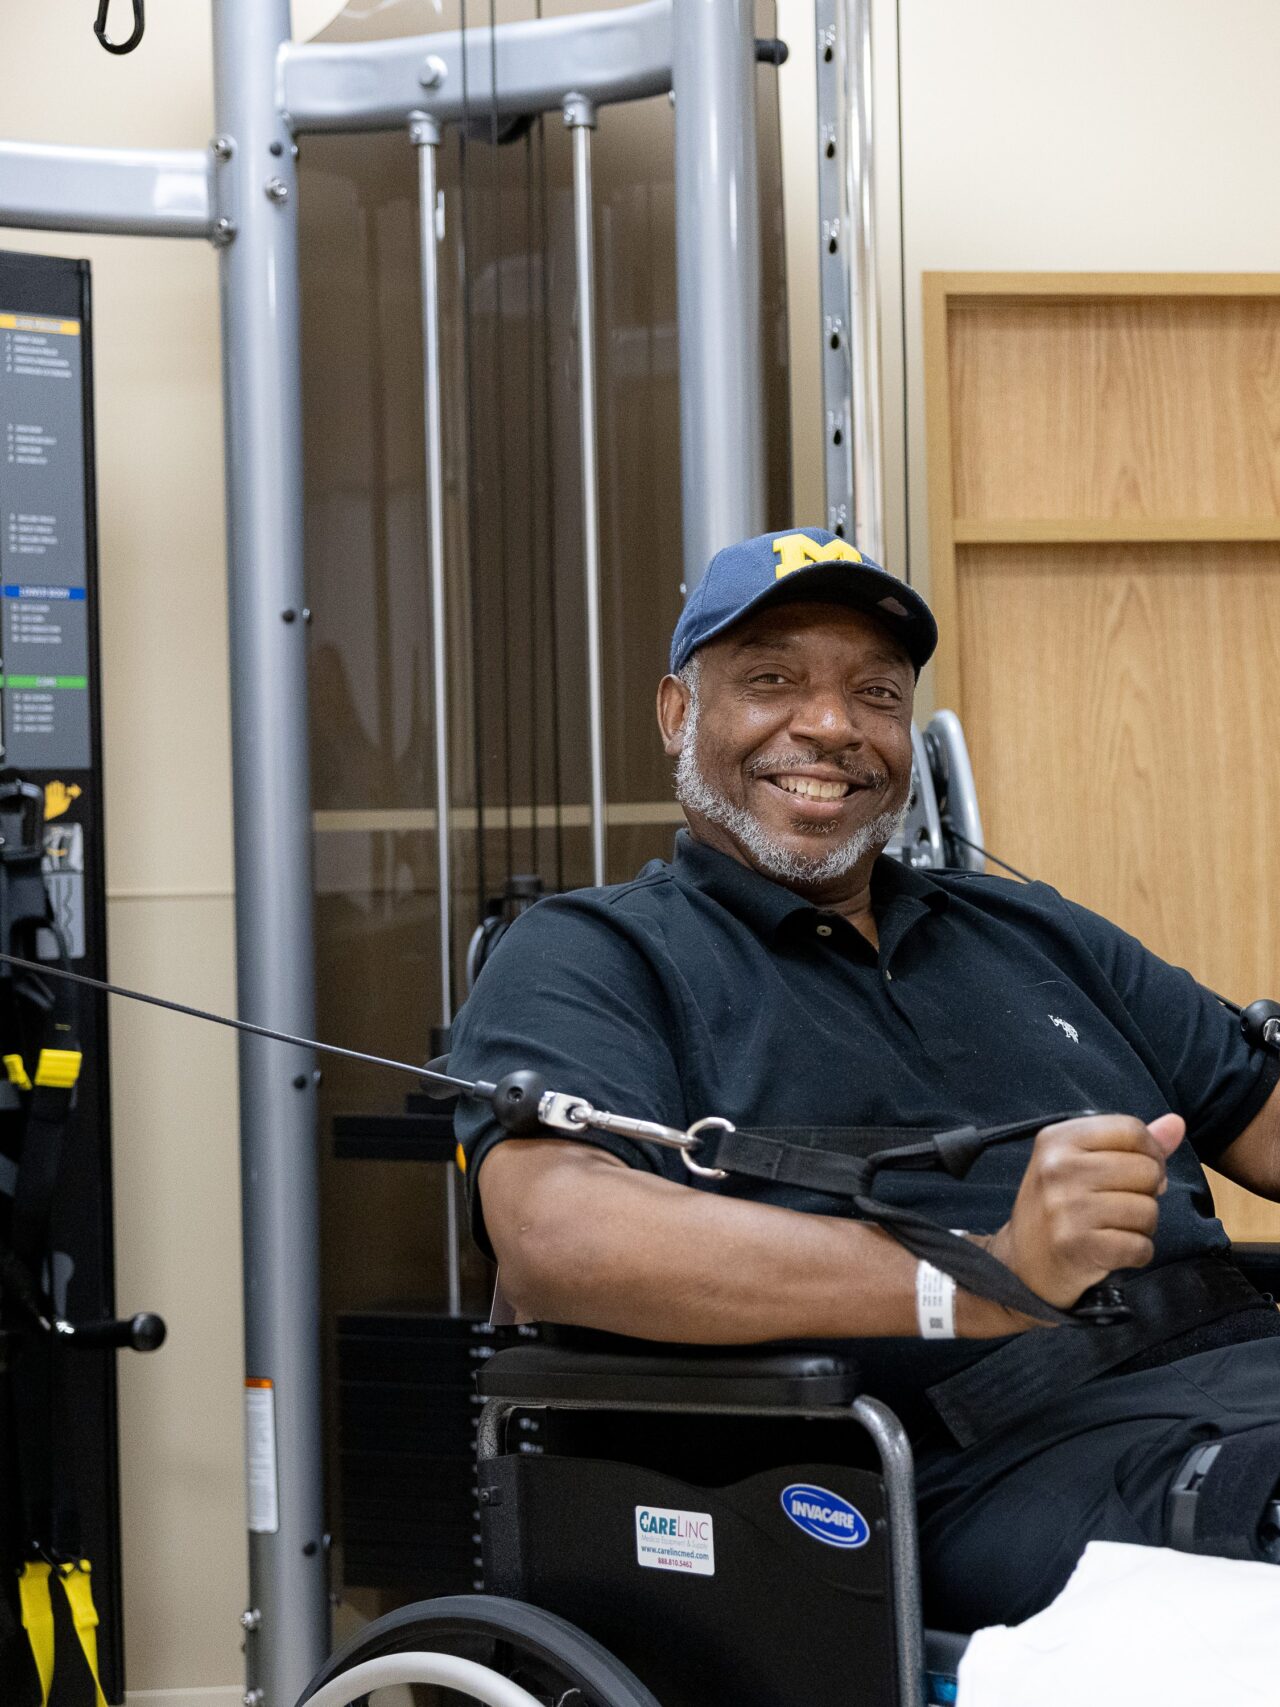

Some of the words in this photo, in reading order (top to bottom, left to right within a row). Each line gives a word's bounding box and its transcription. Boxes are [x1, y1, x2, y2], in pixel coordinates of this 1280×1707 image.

[773, 533, 863, 580] M
[792, 1499, 855, 1530] INVACARE
[641, 1546, 710, 1560] www.carelincmed.com
